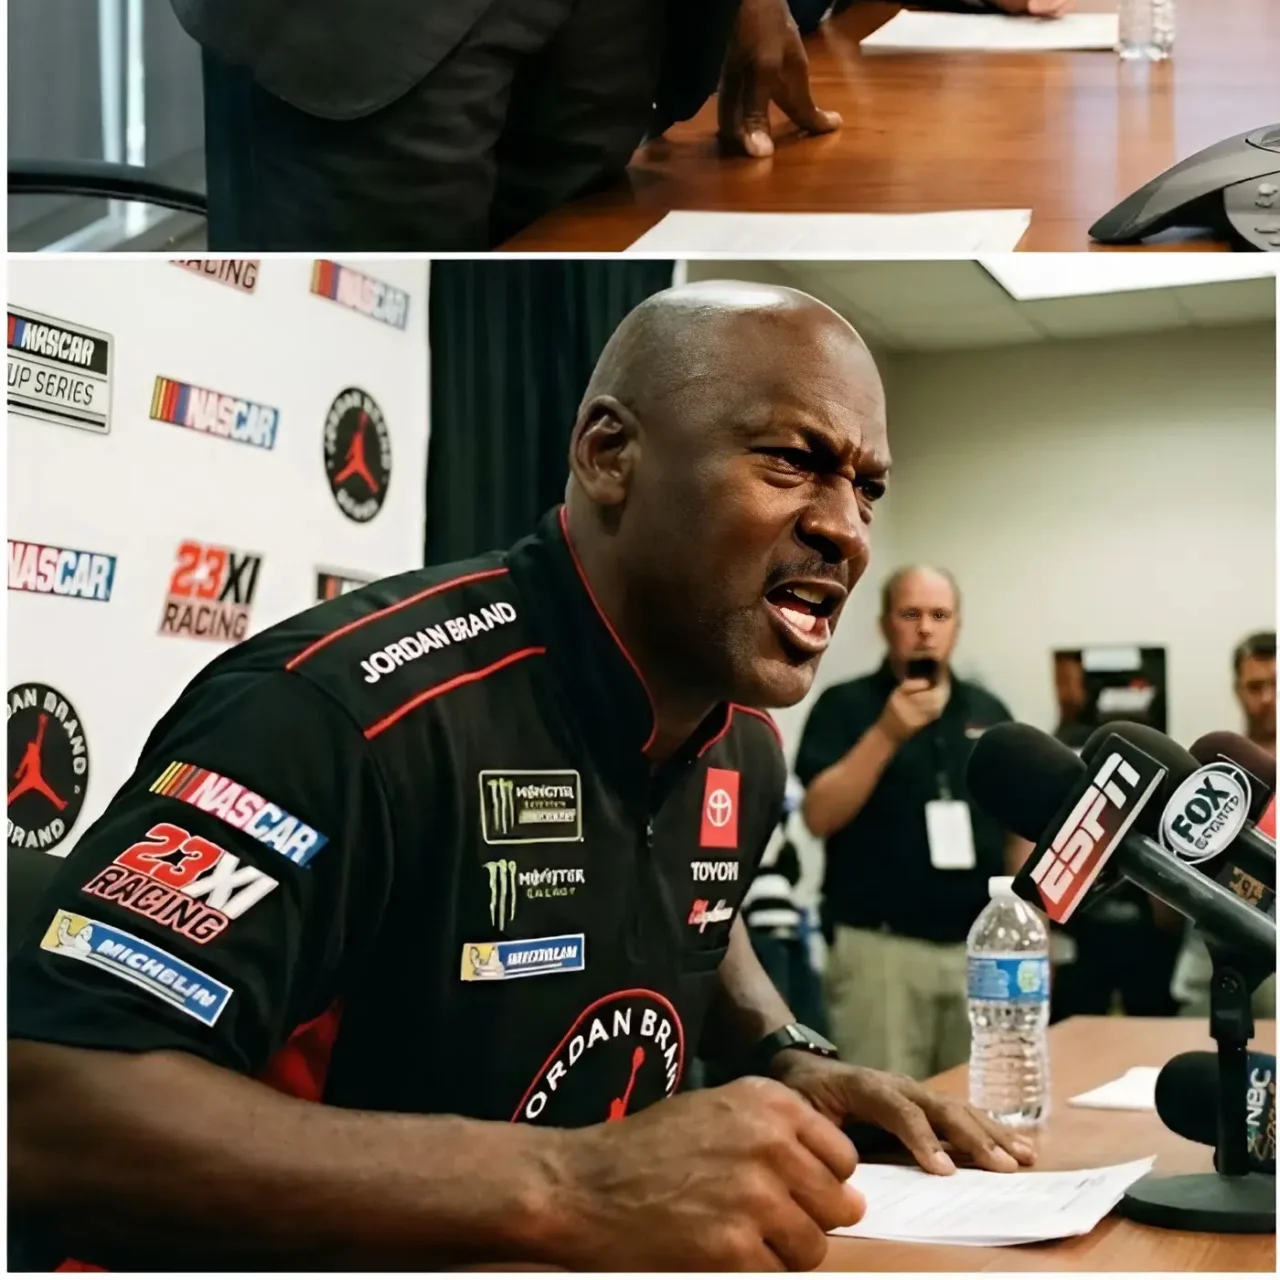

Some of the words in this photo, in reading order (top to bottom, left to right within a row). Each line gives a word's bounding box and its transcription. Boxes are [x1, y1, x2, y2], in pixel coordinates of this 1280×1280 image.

[20, 322, 95, 366] NASCAR
[34, 371, 95, 406] SERIES
[184, 383, 277, 449] NASCAR
[8, 541, 111, 600] NASCAR
[171, 541, 262, 604] 23XI
[161, 602, 248, 639] RACING
[360, 624, 450, 684] JORDAN
[449, 601, 517, 642] BRAND
[186, 772, 318, 863] NASCAR
[1030, 752, 1141, 905] ESPN
[1171, 776, 1230, 844] FOX
[88, 867, 226, 942] RACING
[113, 823, 279, 920] 23XI
[525, 1007, 632, 1119] ORDAN
[1246, 1067, 1272, 1126] NBC
